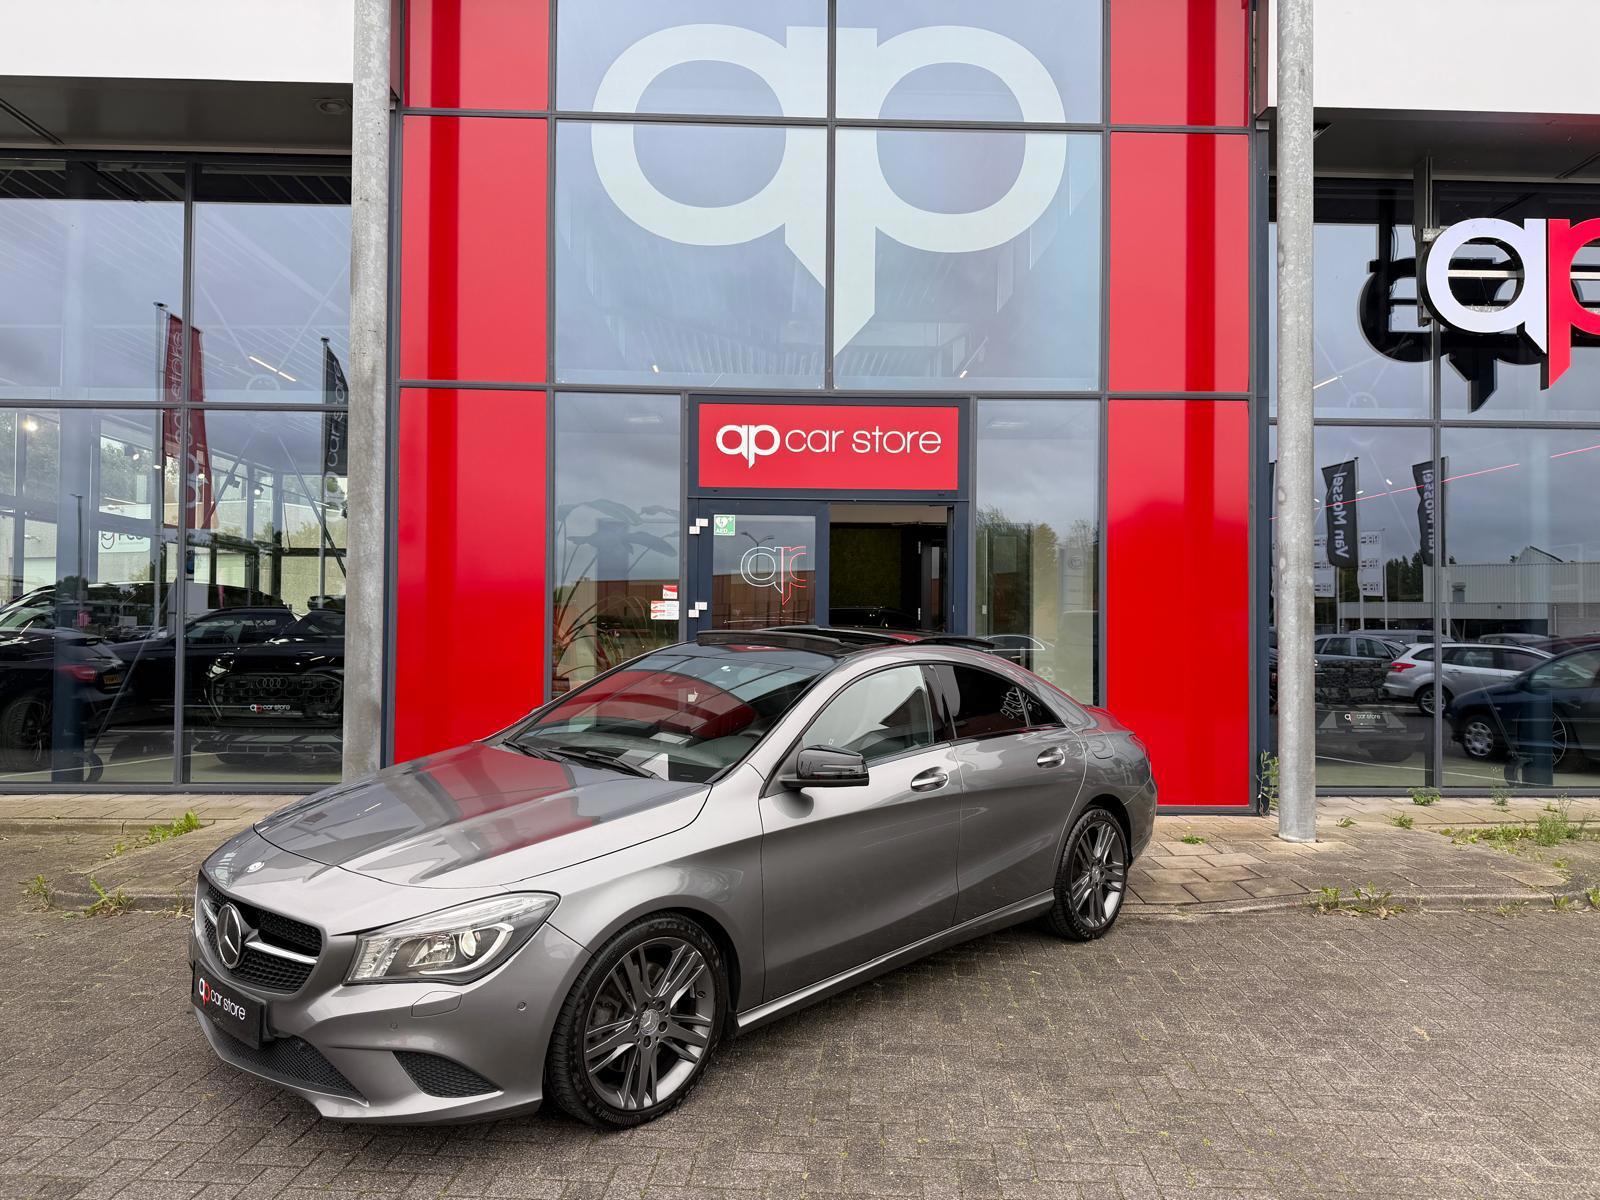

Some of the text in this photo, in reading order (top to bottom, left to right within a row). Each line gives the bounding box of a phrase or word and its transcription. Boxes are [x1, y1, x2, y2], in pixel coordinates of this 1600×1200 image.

[785, 429, 844, 452] car
[852, 425, 942, 454] store
[211, 989, 222, 1007] car
[223, 998, 246, 1020] store
